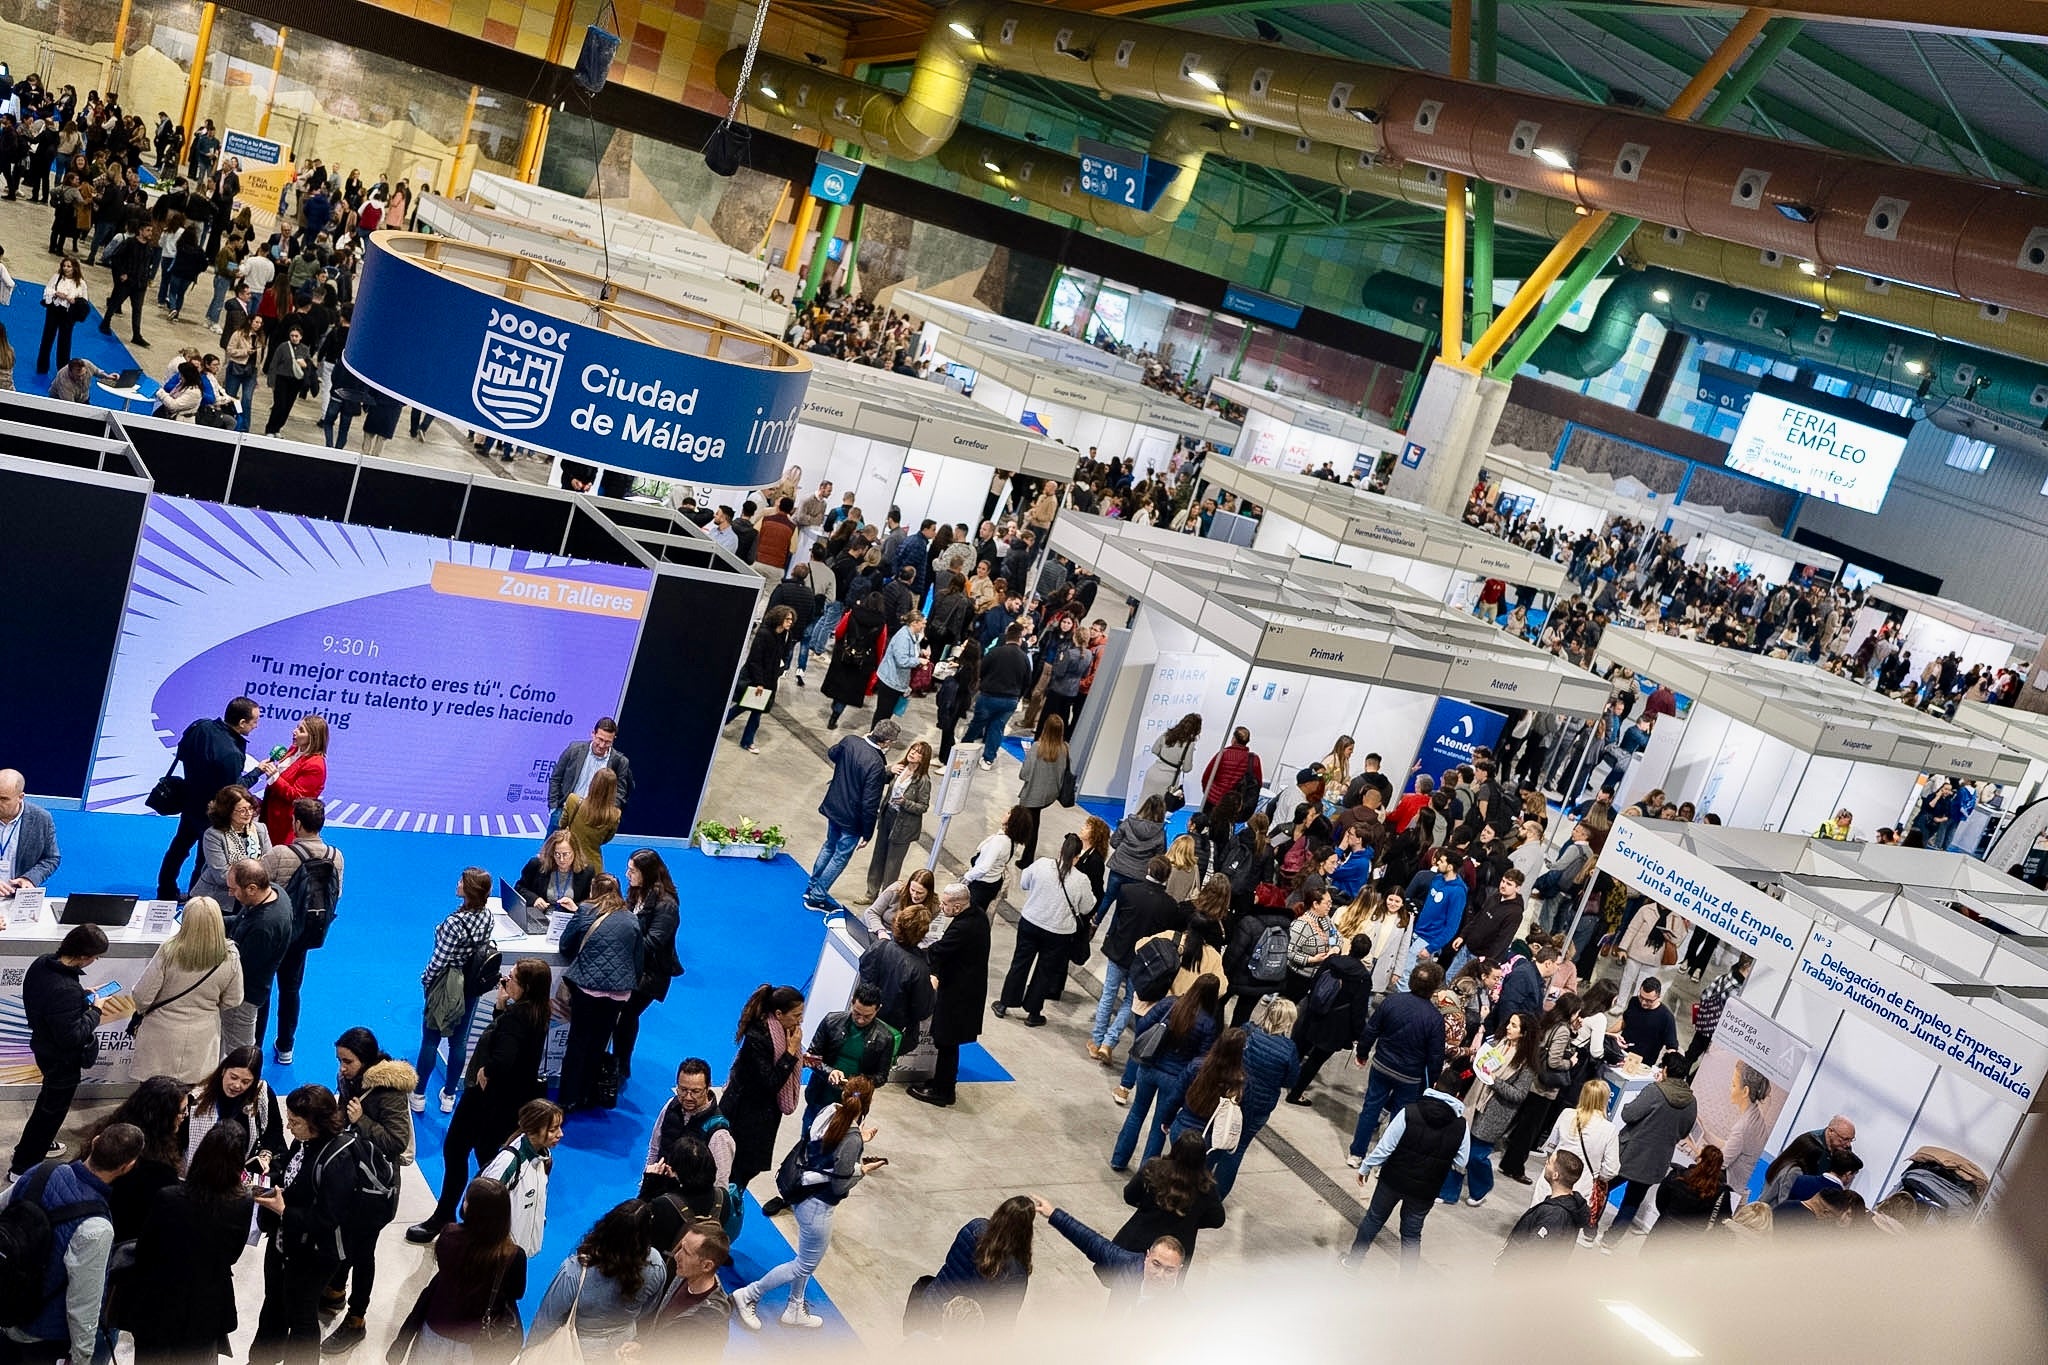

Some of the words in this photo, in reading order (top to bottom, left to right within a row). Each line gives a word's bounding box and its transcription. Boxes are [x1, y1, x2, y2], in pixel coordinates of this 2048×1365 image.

[249, 175, 268, 184] FERIA
[252, 182, 279, 192] EMPLEO
[1124, 177, 1136, 204] 2
[544, 254, 566, 267] Sando
[682, 291, 708, 303] Airzone
[581, 364, 699, 416] Ciudad
[810, 402, 844, 417] Services
[570, 403, 614, 436] de
[621, 414, 726, 463] Málaga
[1782, 407, 1837, 438] FERIA
[952, 436, 989, 450] Carrefour
[1262, 431, 1274, 441] KFC
[1786, 428, 1866, 464] EMPLEO
[1251, 454, 1271, 466] KFC
[1289, 446, 1308, 457] KFC
[1764, 448, 1793, 462] Ciudad
[498, 576, 550, 600] Zona
[557, 584, 633, 612] Talleres
[322, 635, 364, 656] 9:30
[368, 640, 380, 658] h
[1310, 648, 1345, 662] Primark
[252, 654, 284, 674] "Tu
[289, 662, 344, 682] mejor
[348, 669, 427, 690] contacto
[431, 678, 469, 694] eres
[473, 680, 504, 698] tú".
[510, 684, 556, 703] Cómo
[1490, 678, 1518, 692] Atende
[244, 681, 338, 702] potenciar
[342, 688, 360, 705] tu
[364, 691, 428, 712] talento
[432, 700, 443, 716] y
[446, 700, 494, 719] redes
[498, 704, 574, 726] haciendo
[258, 702, 352, 730] etworking
[1436, 734, 1476, 754] Atende
[1616, 826, 1628, 836] Nº
[1628, 832, 1634, 840] 1
[1616, 840, 1664, 876] Servicio
[1666, 870, 1720, 908] Andaluz
[1721, 900, 1738, 918] de
[1740, 910, 1794, 951] Empleo.
[1636, 869, 1672, 897] Junta
[1674, 890, 1692, 908] de
[1692, 902, 1759, 947] Andalucía
[1813, 932, 1826, 943] Nº
[1826, 939, 1832, 949] 3
[1726, 1010, 1758, 1035] Descarga
[1820, 952, 1886, 1000] Delegación
[1886, 991, 1904, 1008] de
[1904, 1000, 1952, 1038] Empleo,
[1954, 1027, 2012, 1069] Empresa
[2009, 1062, 2022, 1076] y
[1721, 1019, 1728, 1028] la
[1728, 1024, 1744, 1036] APP
[1744, 1034, 1757, 1046] del
[1756, 1042, 1771, 1056] SAE
[1800, 958, 1844, 993] Trabajo
[1844, 984, 1910, 1032] Autónomo.
[1910, 1024, 1946, 1052] Junta
[1946, 1044, 1965, 1062] de
[1964, 1053, 2032, 1100] Andalucía
